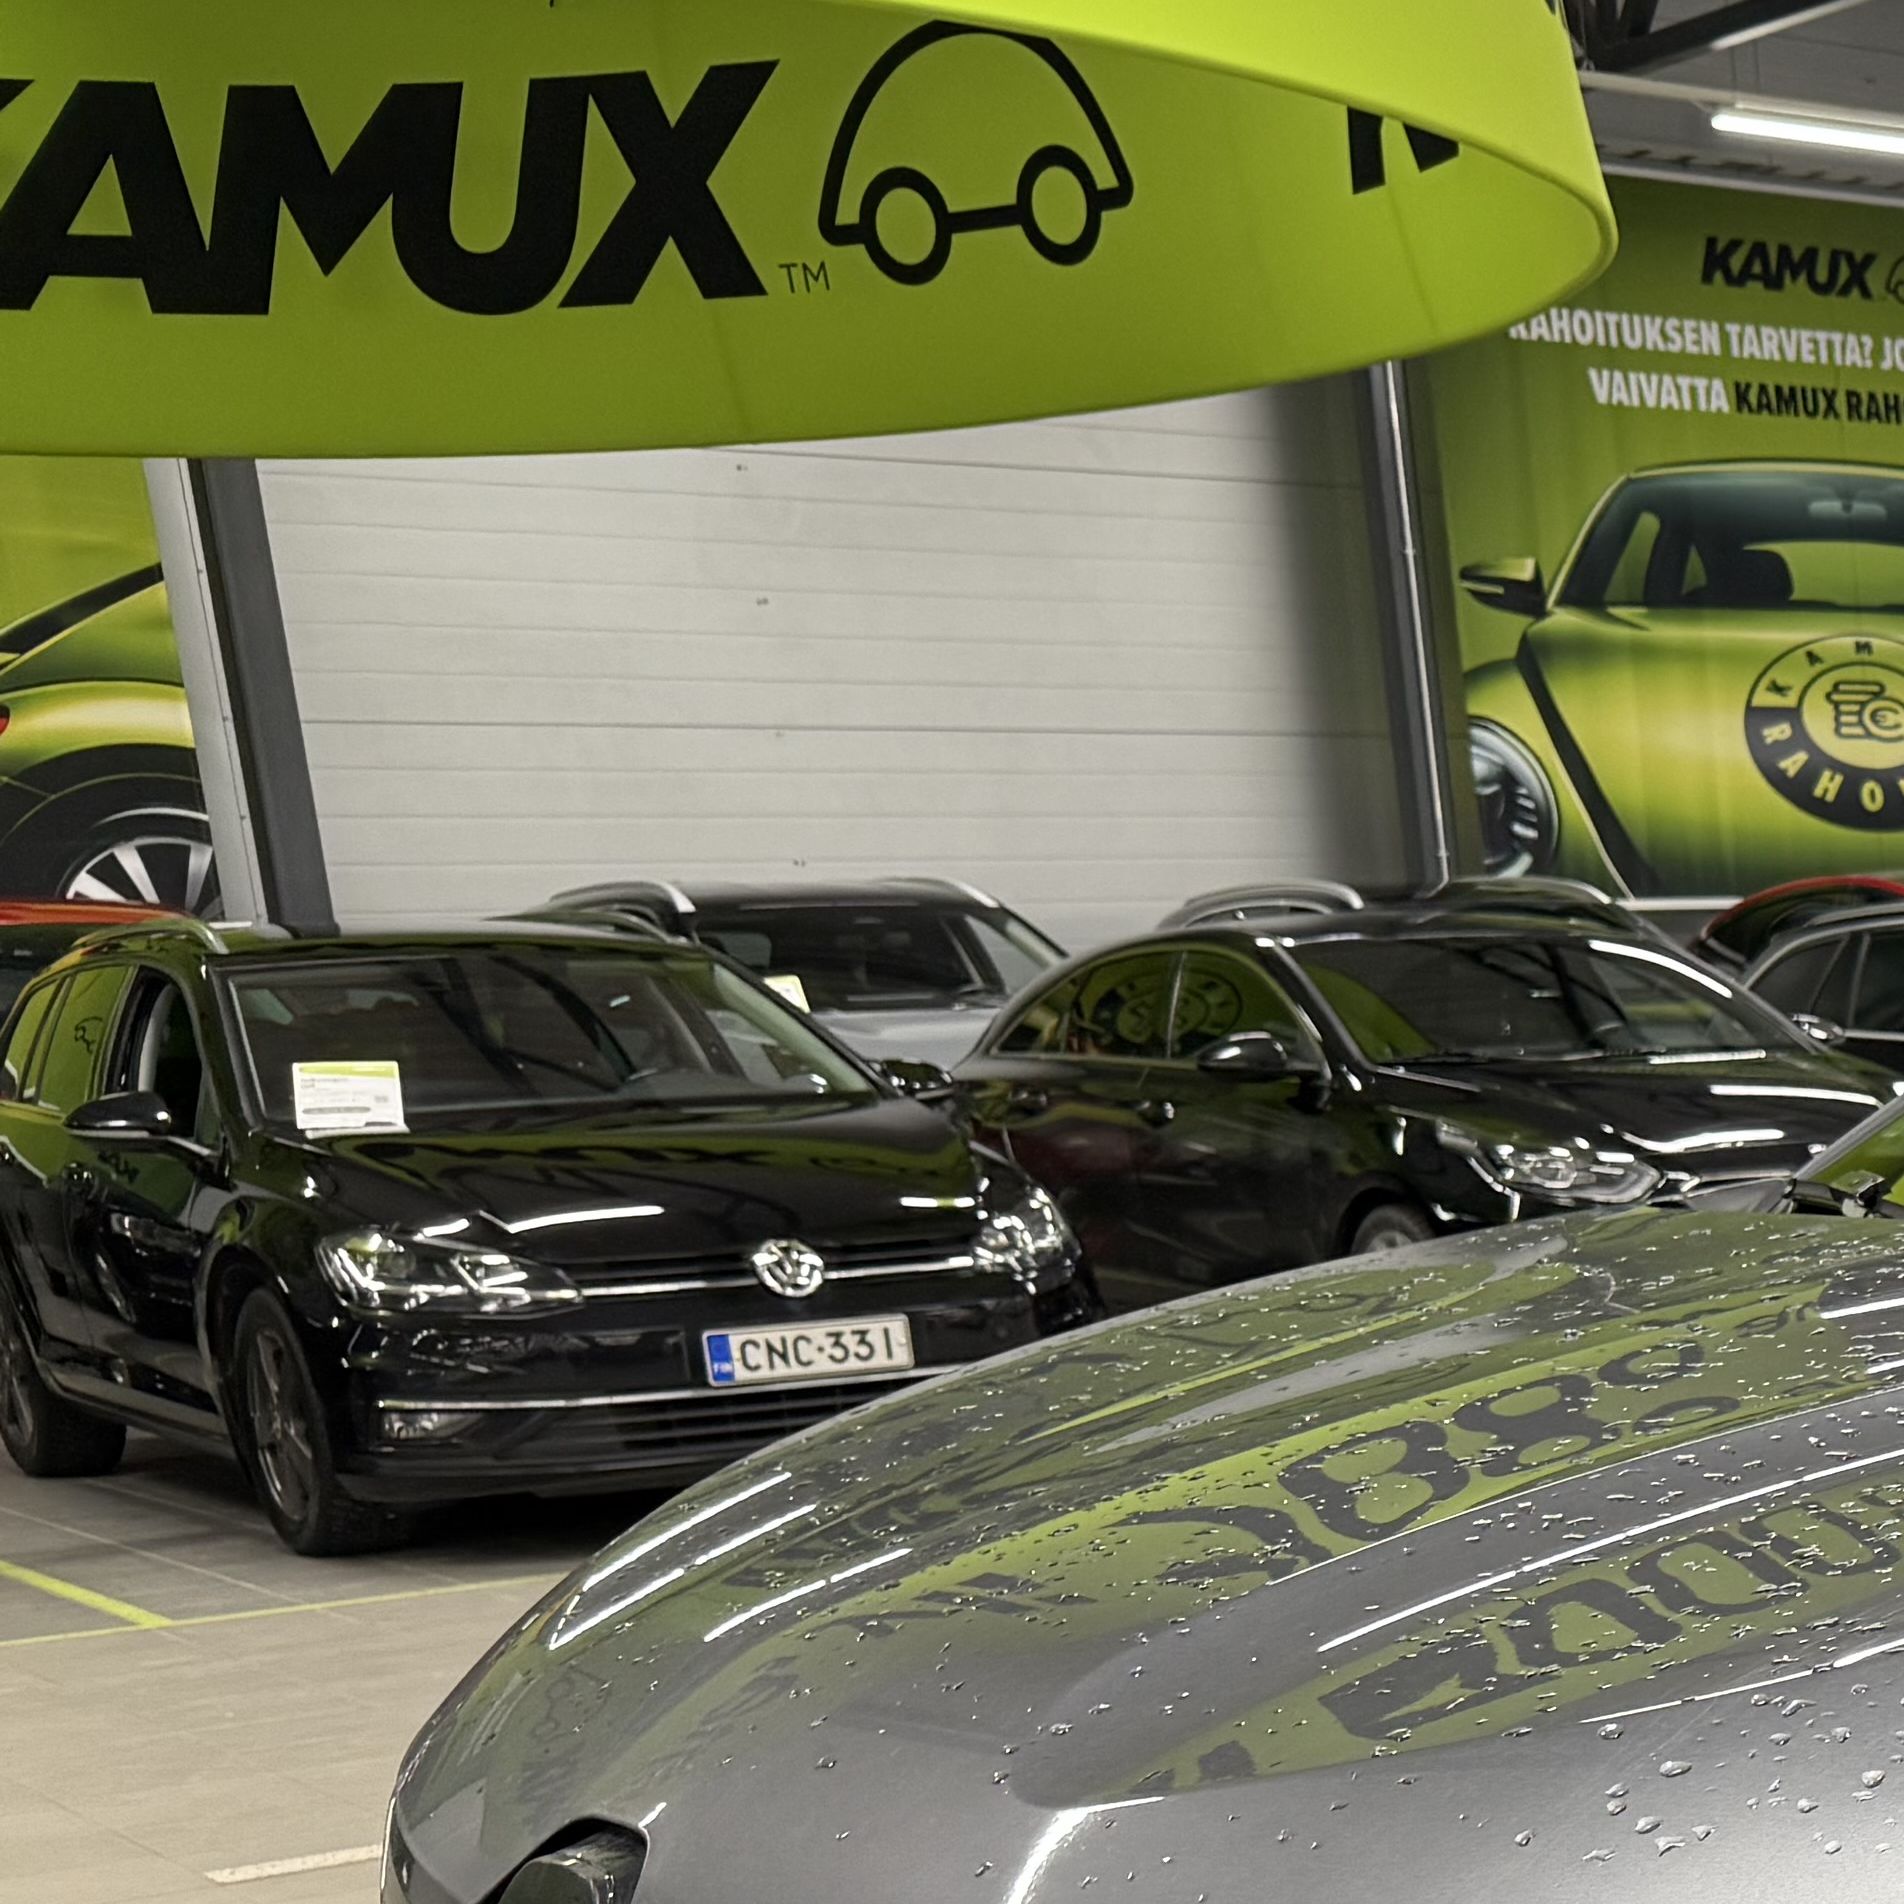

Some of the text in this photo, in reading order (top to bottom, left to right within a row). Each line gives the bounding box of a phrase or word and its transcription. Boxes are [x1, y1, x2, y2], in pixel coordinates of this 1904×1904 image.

[0, 59, 830, 316] AMUX TM
[1701, 236, 1877, 300] KAMUX
[1725, 322, 1873, 367] TARVETTA?
[1588, 367, 1730, 414] VAIVATTA
[1734, 380, 1841, 421] KAMUX
[739, 1327, 895, 1372] CNC-331
